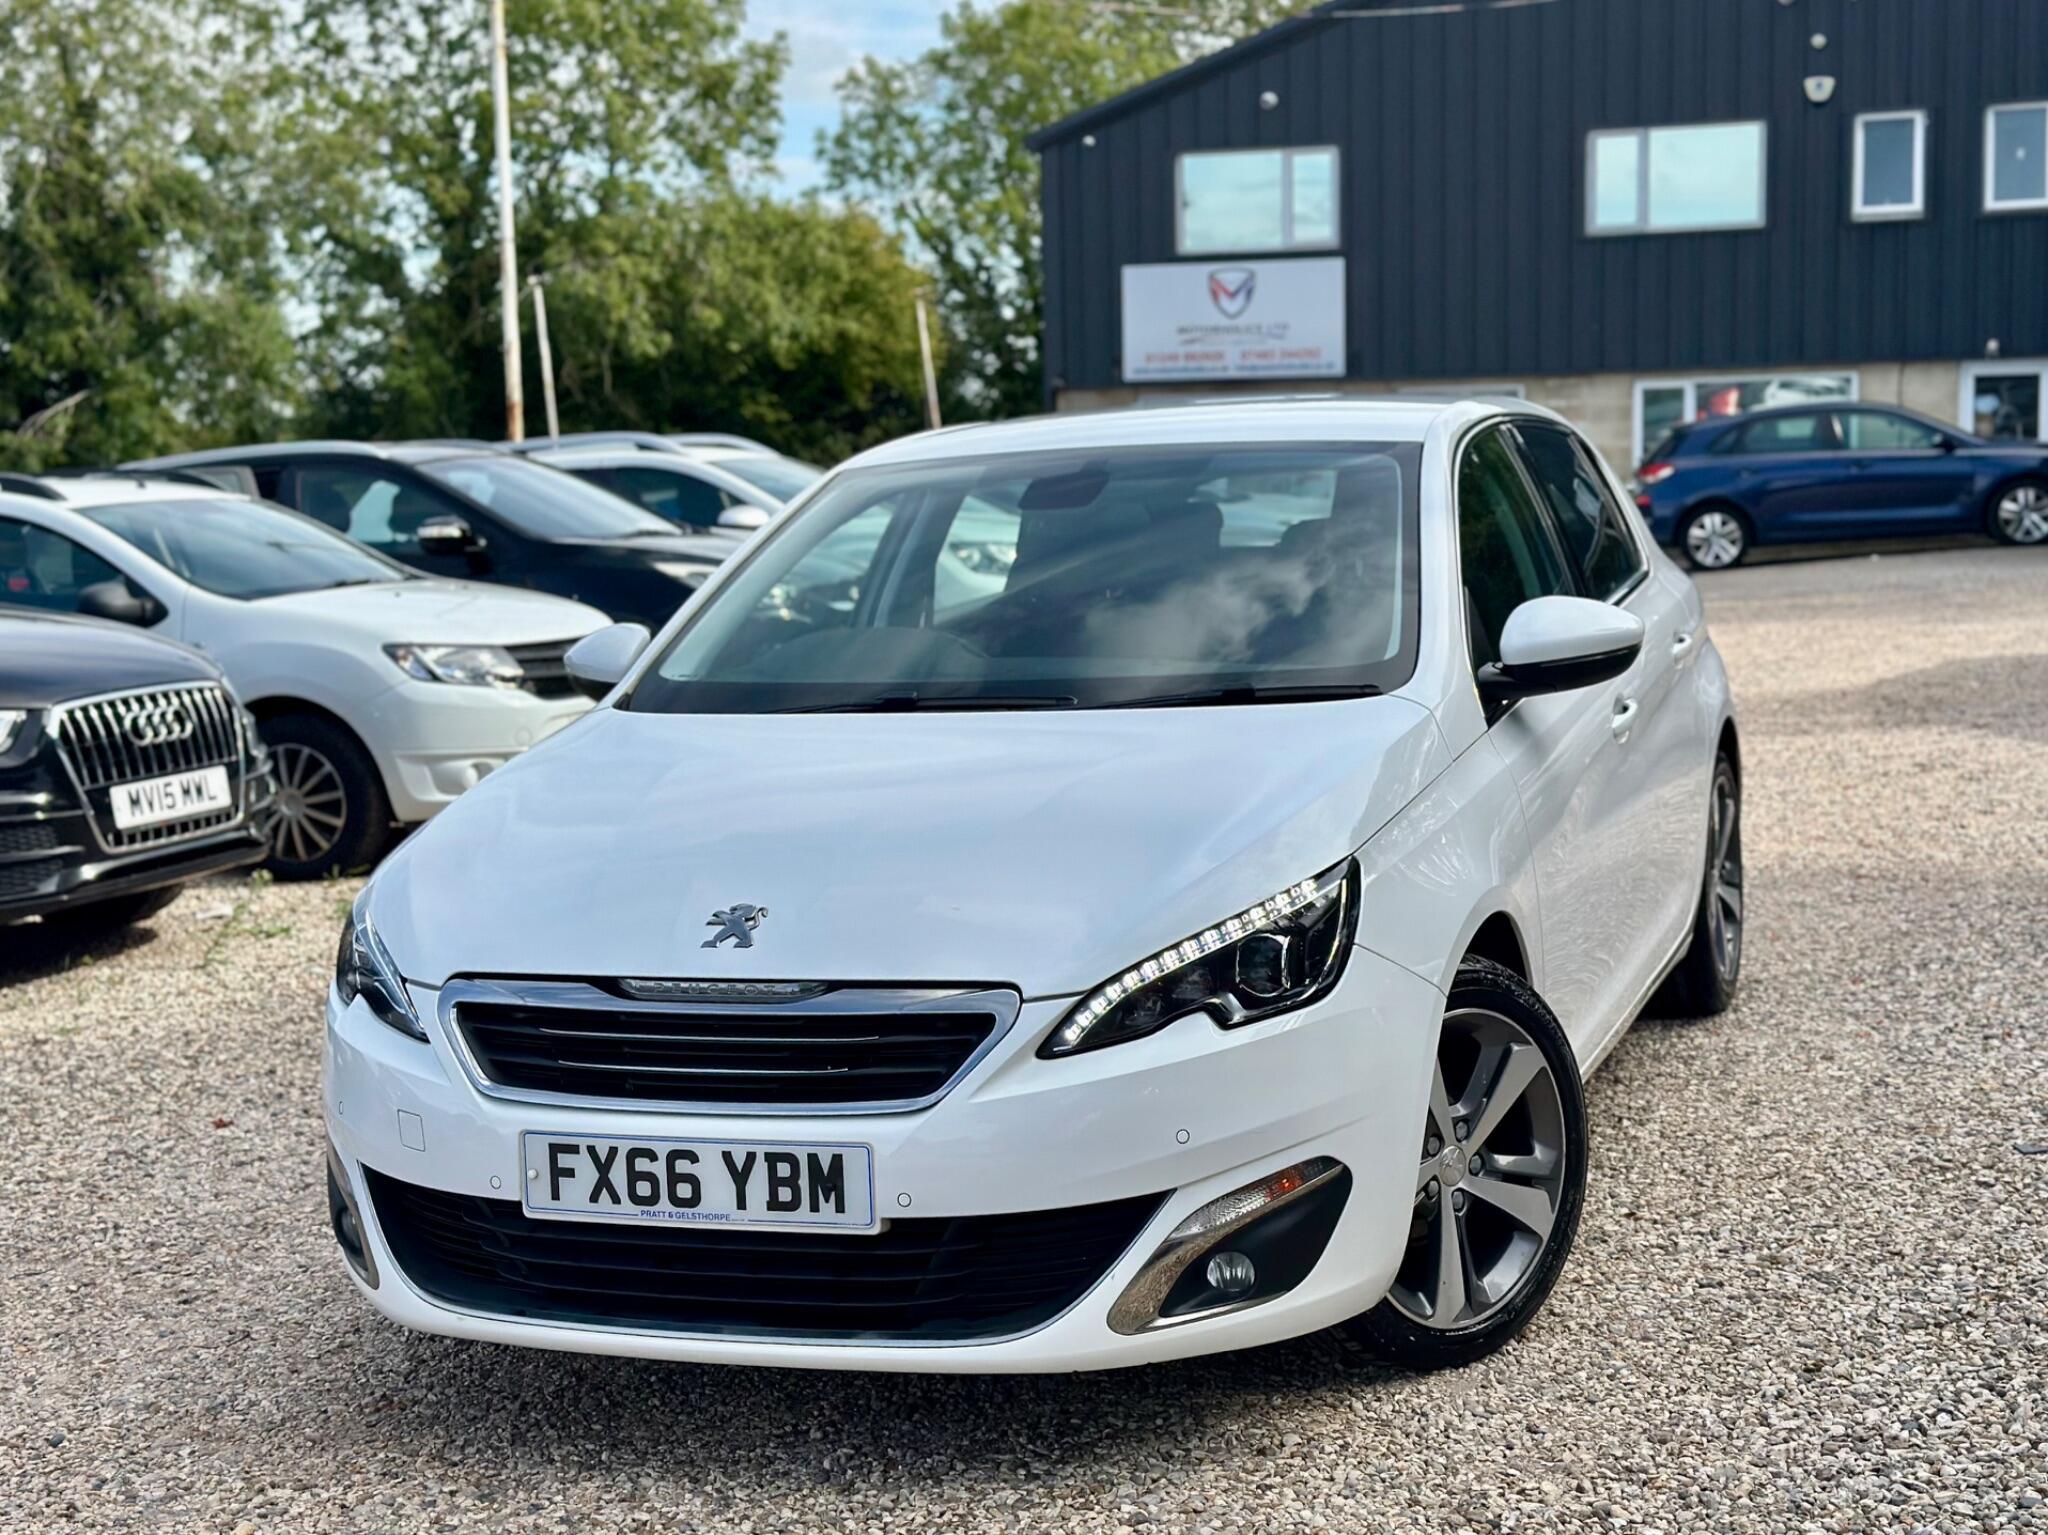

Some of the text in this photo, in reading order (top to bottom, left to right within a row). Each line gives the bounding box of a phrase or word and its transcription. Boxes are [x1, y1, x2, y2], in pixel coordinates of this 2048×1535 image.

[127, 774, 218, 817] MV15 MWL
[652, 981, 776, 995] PEUGEOT
[547, 1142, 846, 1214] FX66 YBM
[640, 1209, 666, 1219] PRATT
[674, 1211, 731, 1222] GELSTHORPE
